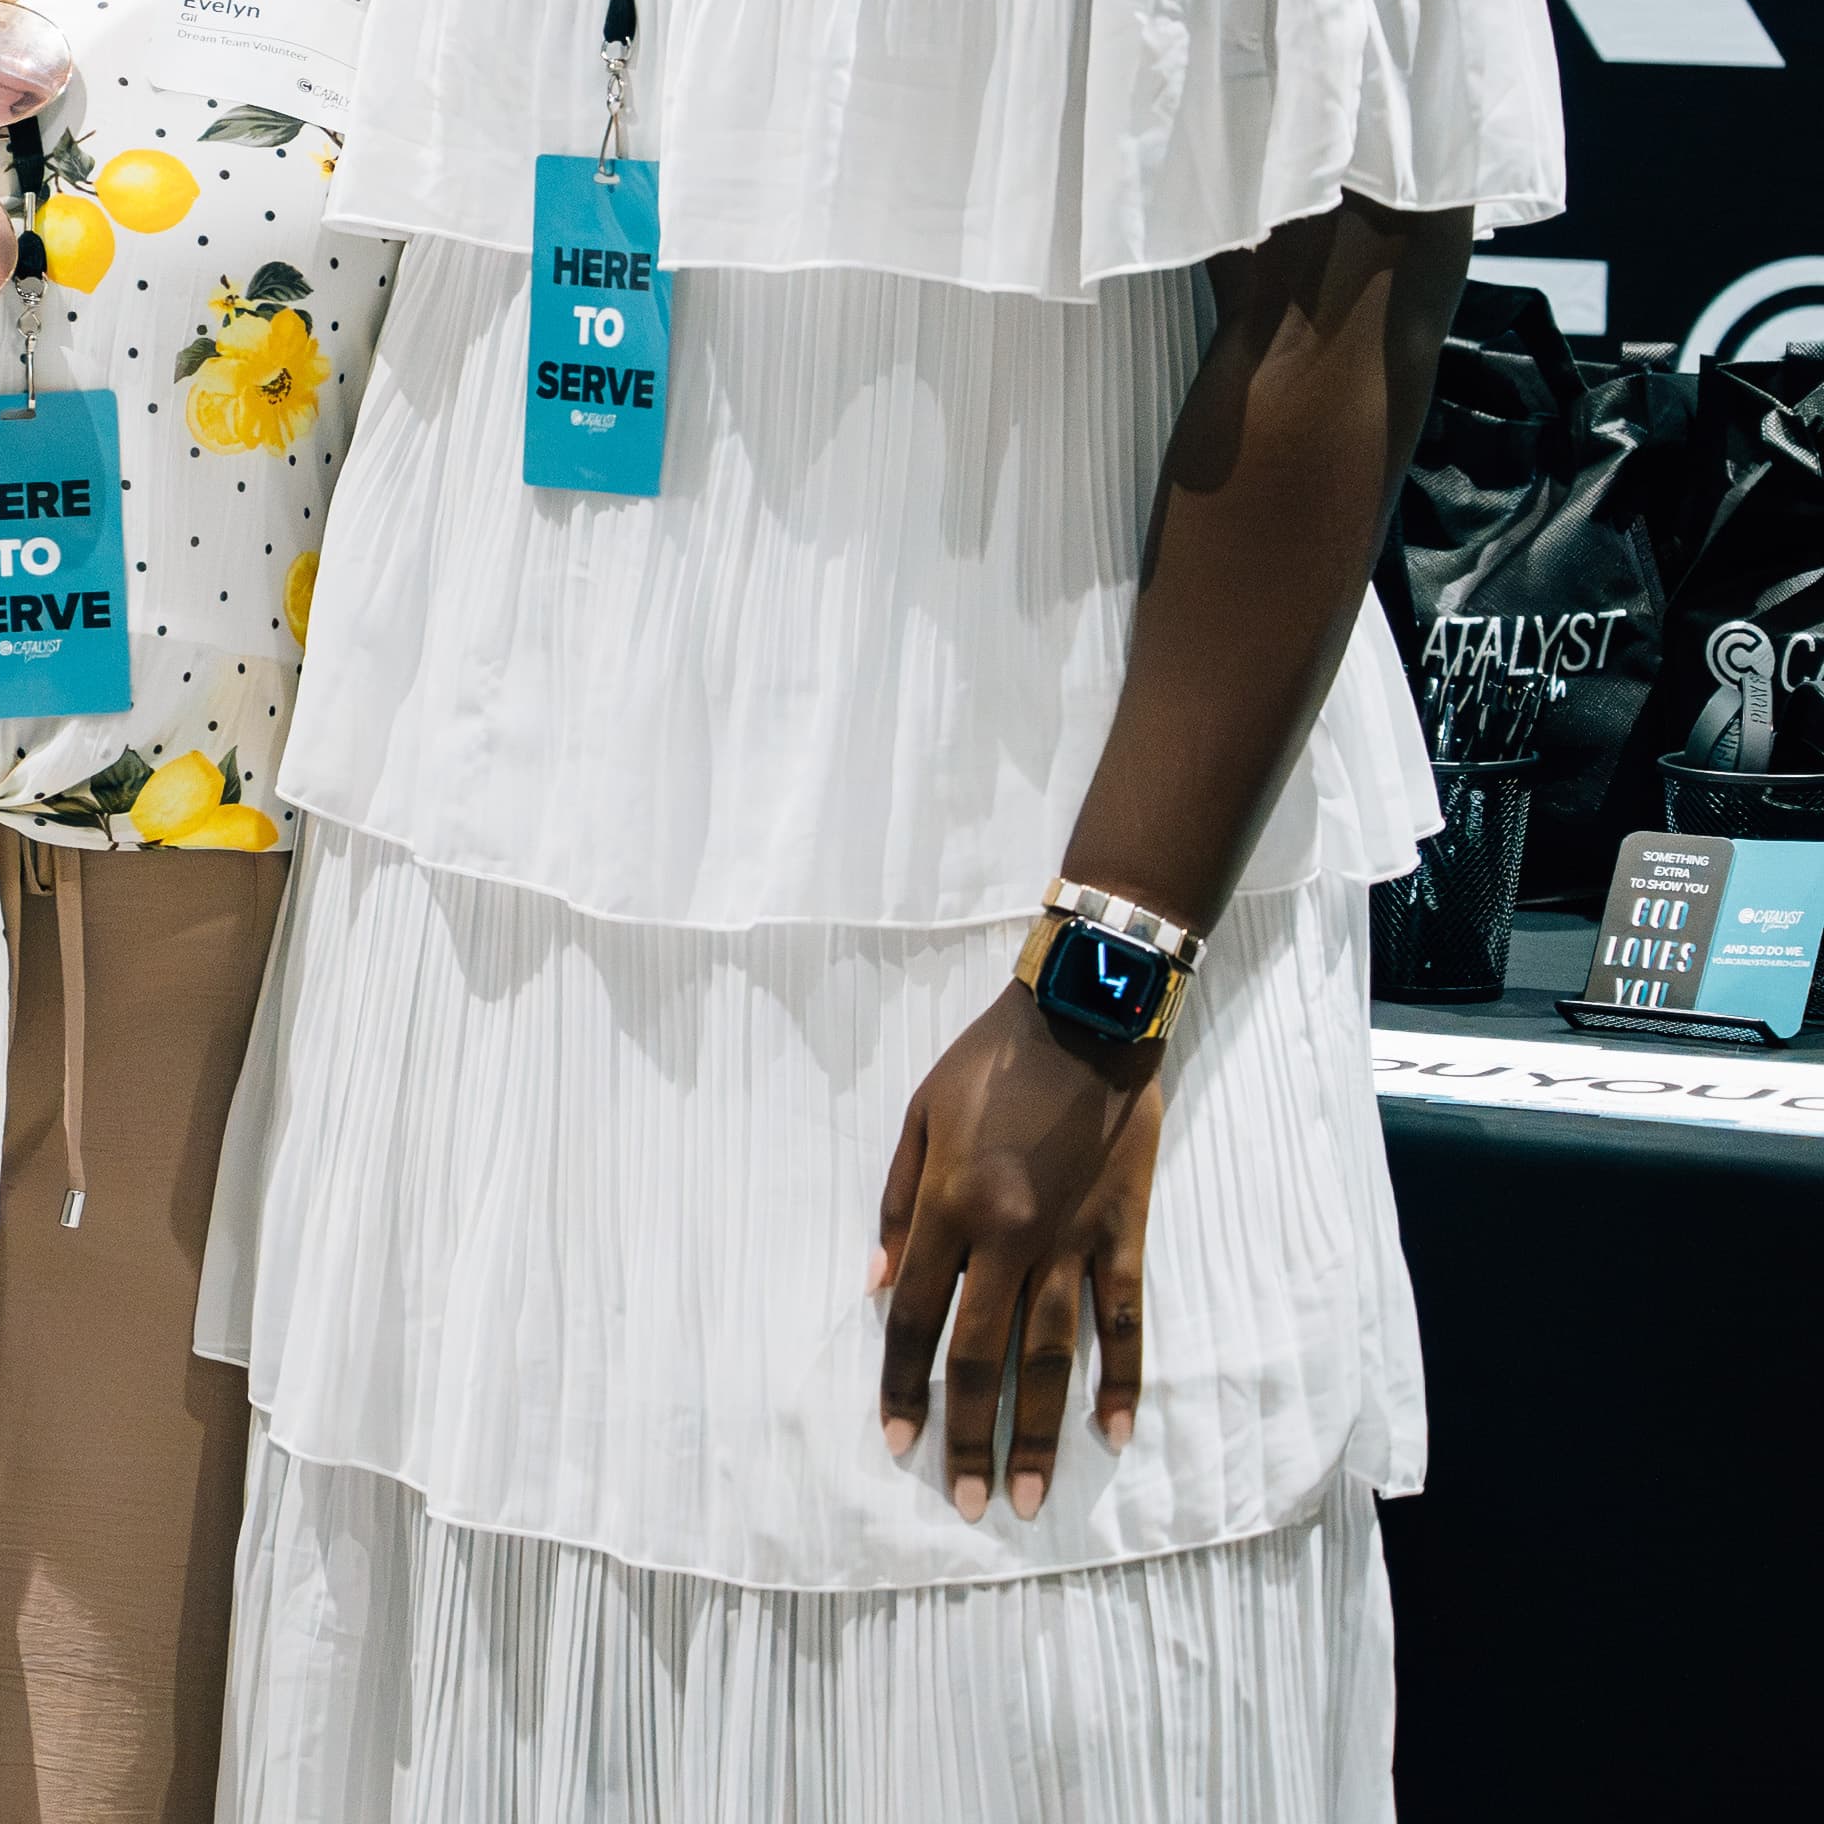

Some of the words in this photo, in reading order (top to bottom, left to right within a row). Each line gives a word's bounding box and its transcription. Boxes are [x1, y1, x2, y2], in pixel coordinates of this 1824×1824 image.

[180, 12, 198, 23] Gil
[177, 29, 217, 44] Dream
[220, 35, 250, 49] Team
[253, 41, 309, 62] Volunteer
[553, 246, 652, 291] HERE
[573, 306, 625, 347] TO
[536, 361, 655, 409] SERVE
[1418, 609, 1628, 676] ATALYST
[1642, 851, 1710, 866] SOMETHING
[1654, 866, 1690, 878] EXTRA
[1630, 877, 1646, 889] TO
[1646, 879, 1684, 892] SHOW
[1685, 883, 1710, 894] YOU
[1631, 897, 1689, 930] GOD
[1753, 910, 1805, 925] CATALYST
[1603, 935, 1697, 973] LOVES
[1723, 944, 1748, 955] AND
[1749, 945, 1765, 955] SO
[1766, 945, 1784, 956] DO
[1615, 978, 1670, 1008] YOU
